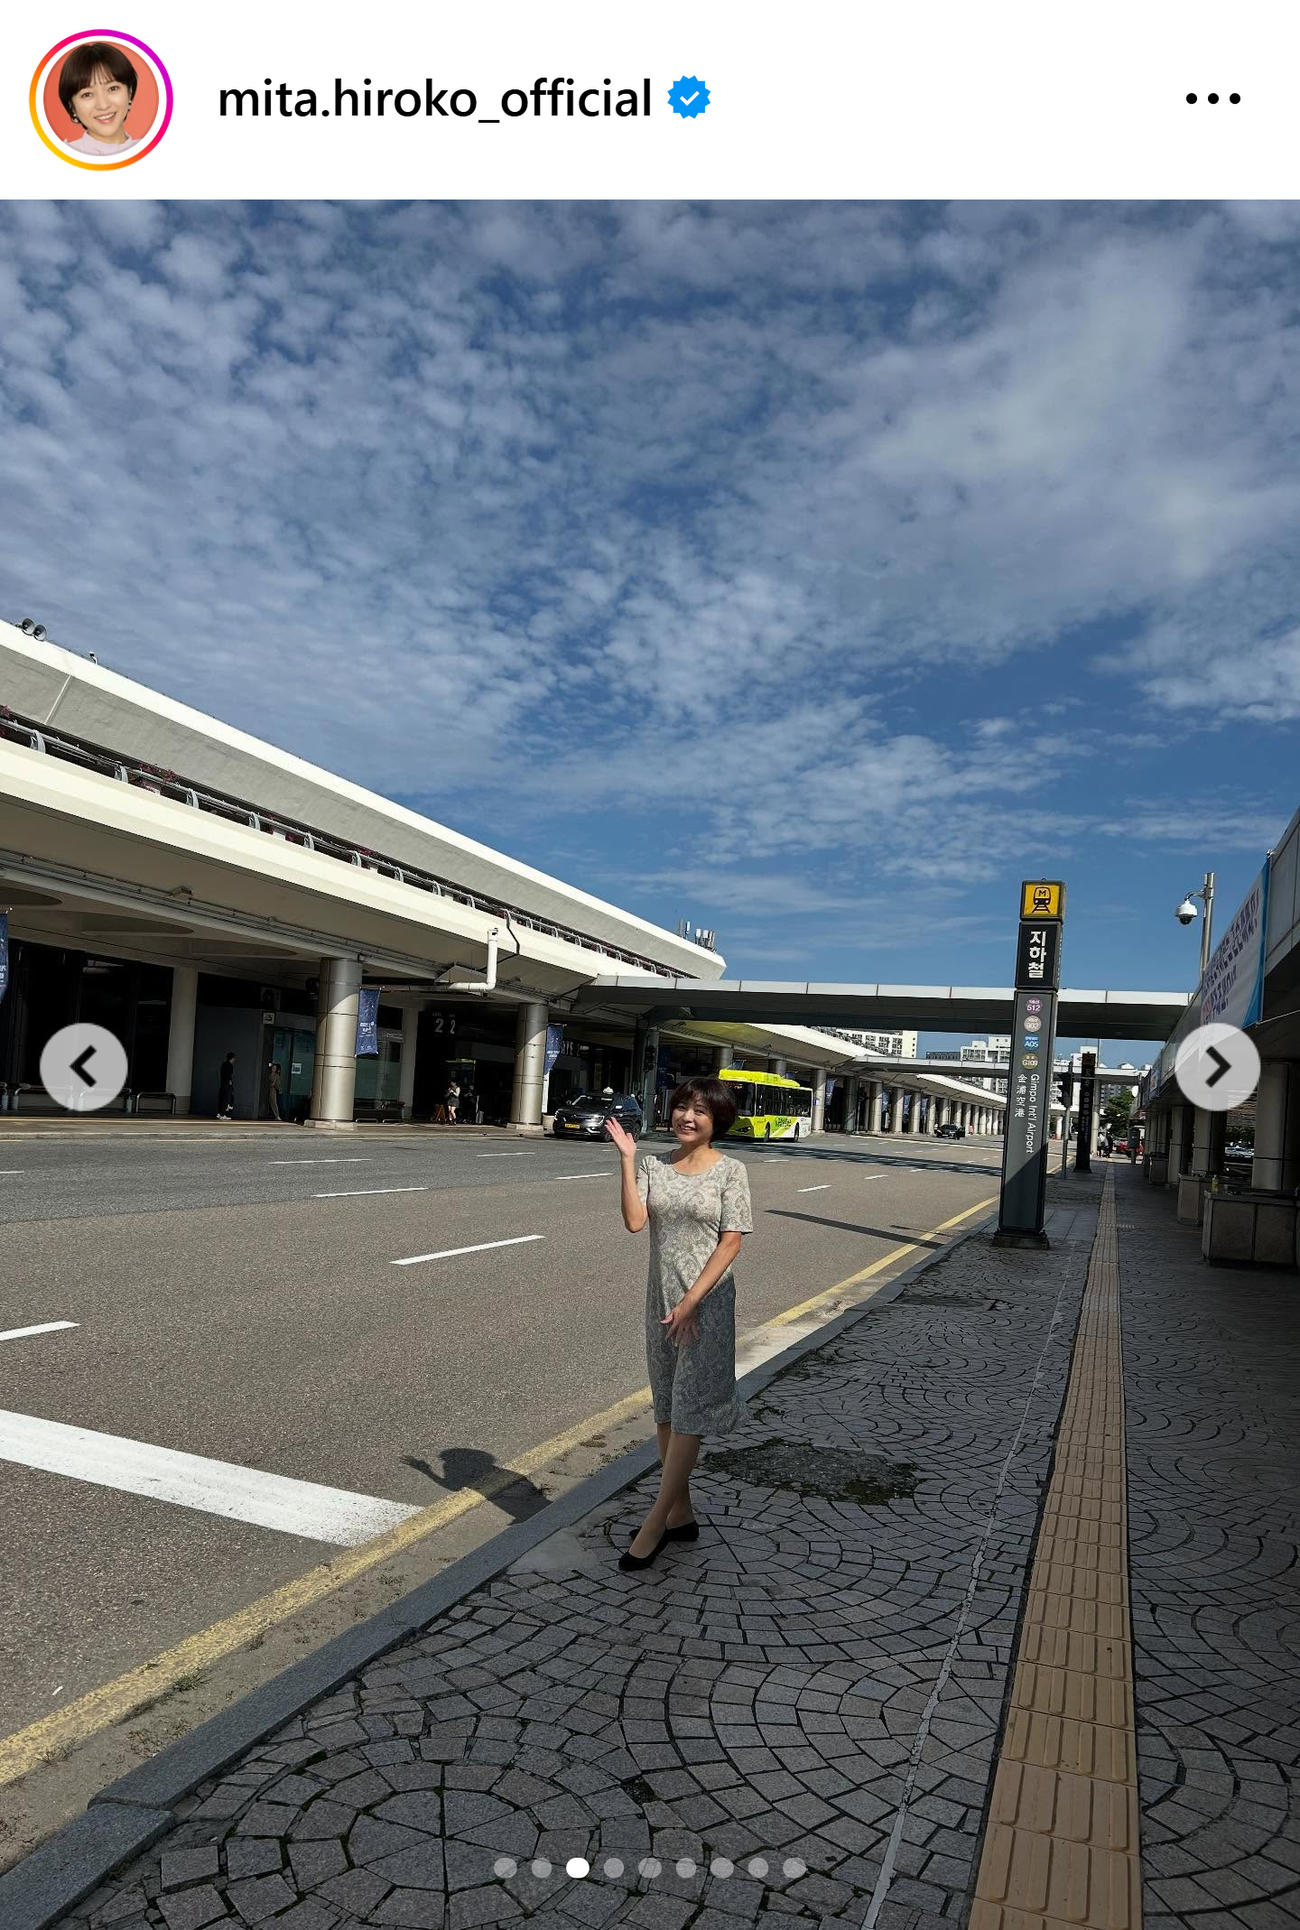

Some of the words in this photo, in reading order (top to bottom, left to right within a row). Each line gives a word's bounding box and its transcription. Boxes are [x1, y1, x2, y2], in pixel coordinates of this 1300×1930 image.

[1028, 931, 1047, 979] 지하철
[1014, 1073, 1028, 1118] 金浦空港
[1029, 1073, 1040, 1102] Gimpo
[1027, 1105, 1038, 1121] Int'l
[1025, 1122, 1037, 1154] Airport
